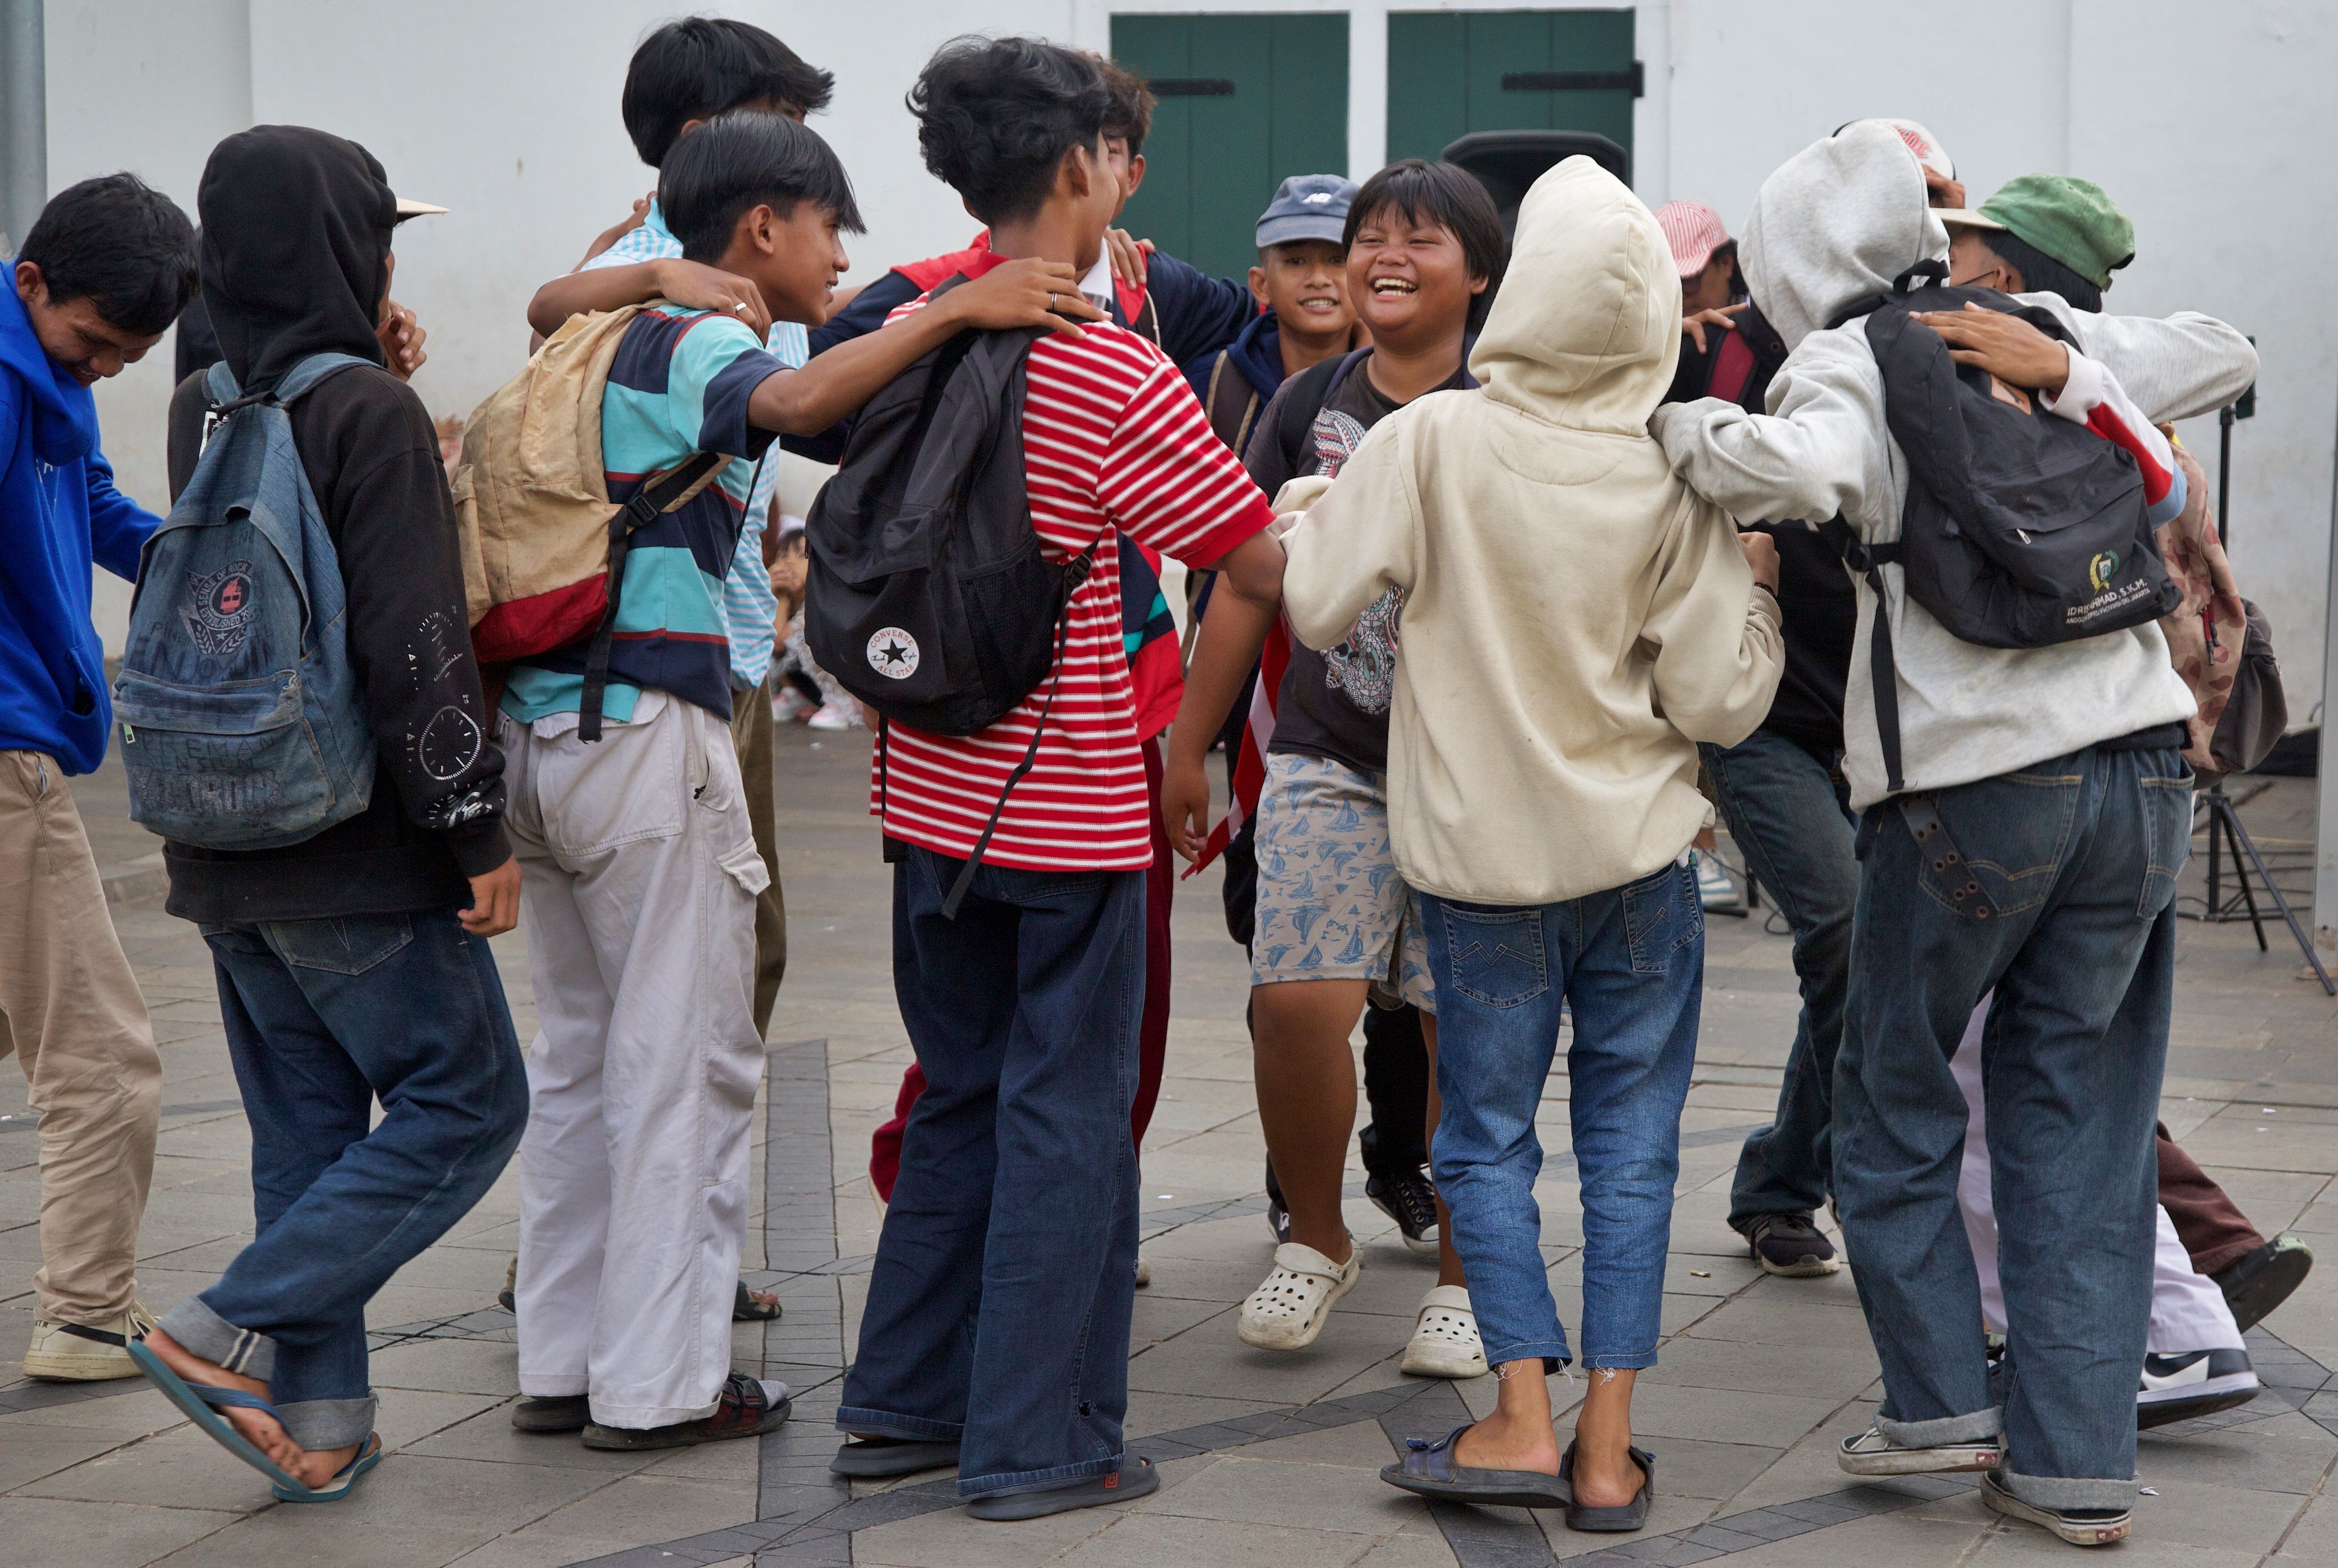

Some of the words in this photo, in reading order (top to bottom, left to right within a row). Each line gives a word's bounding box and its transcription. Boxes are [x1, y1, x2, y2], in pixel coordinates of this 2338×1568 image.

[198, 579, 217, 606] SENSE
[216, 569, 226, 581] OF
[228, 562, 249, 573] ROCK
[199, 607, 240, 627] ESTABLISHED
[870, 629, 914, 648] CONVERSE
[877, 665, 893, 676] ALL
[896, 664, 914, 677] STAR
